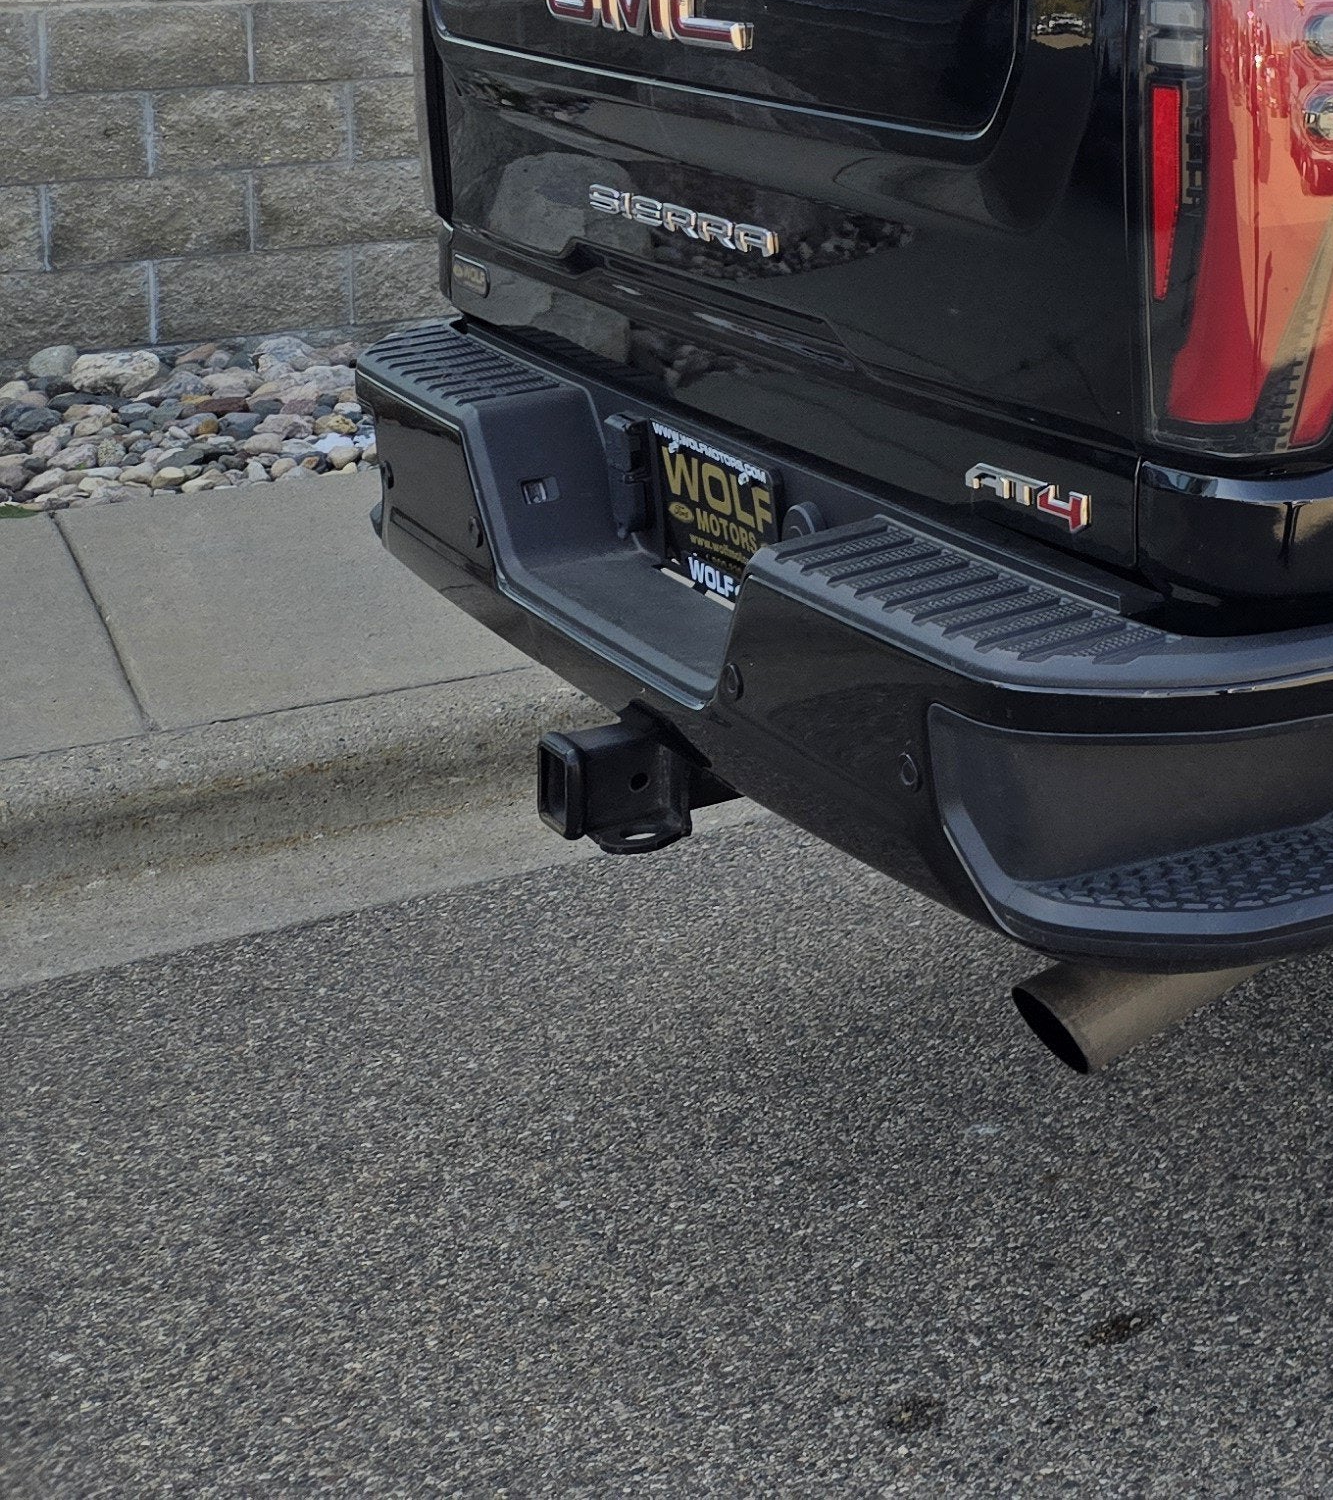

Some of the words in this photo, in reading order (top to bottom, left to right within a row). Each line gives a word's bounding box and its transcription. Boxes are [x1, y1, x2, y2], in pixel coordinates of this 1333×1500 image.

[588, 183, 779, 258] SIERRA
[662, 446, 773, 534] WOLF
[965, 462, 1092, 534] AT4
[695, 508, 758, 555] MOTORS
[688, 556, 735, 598] WOLF
